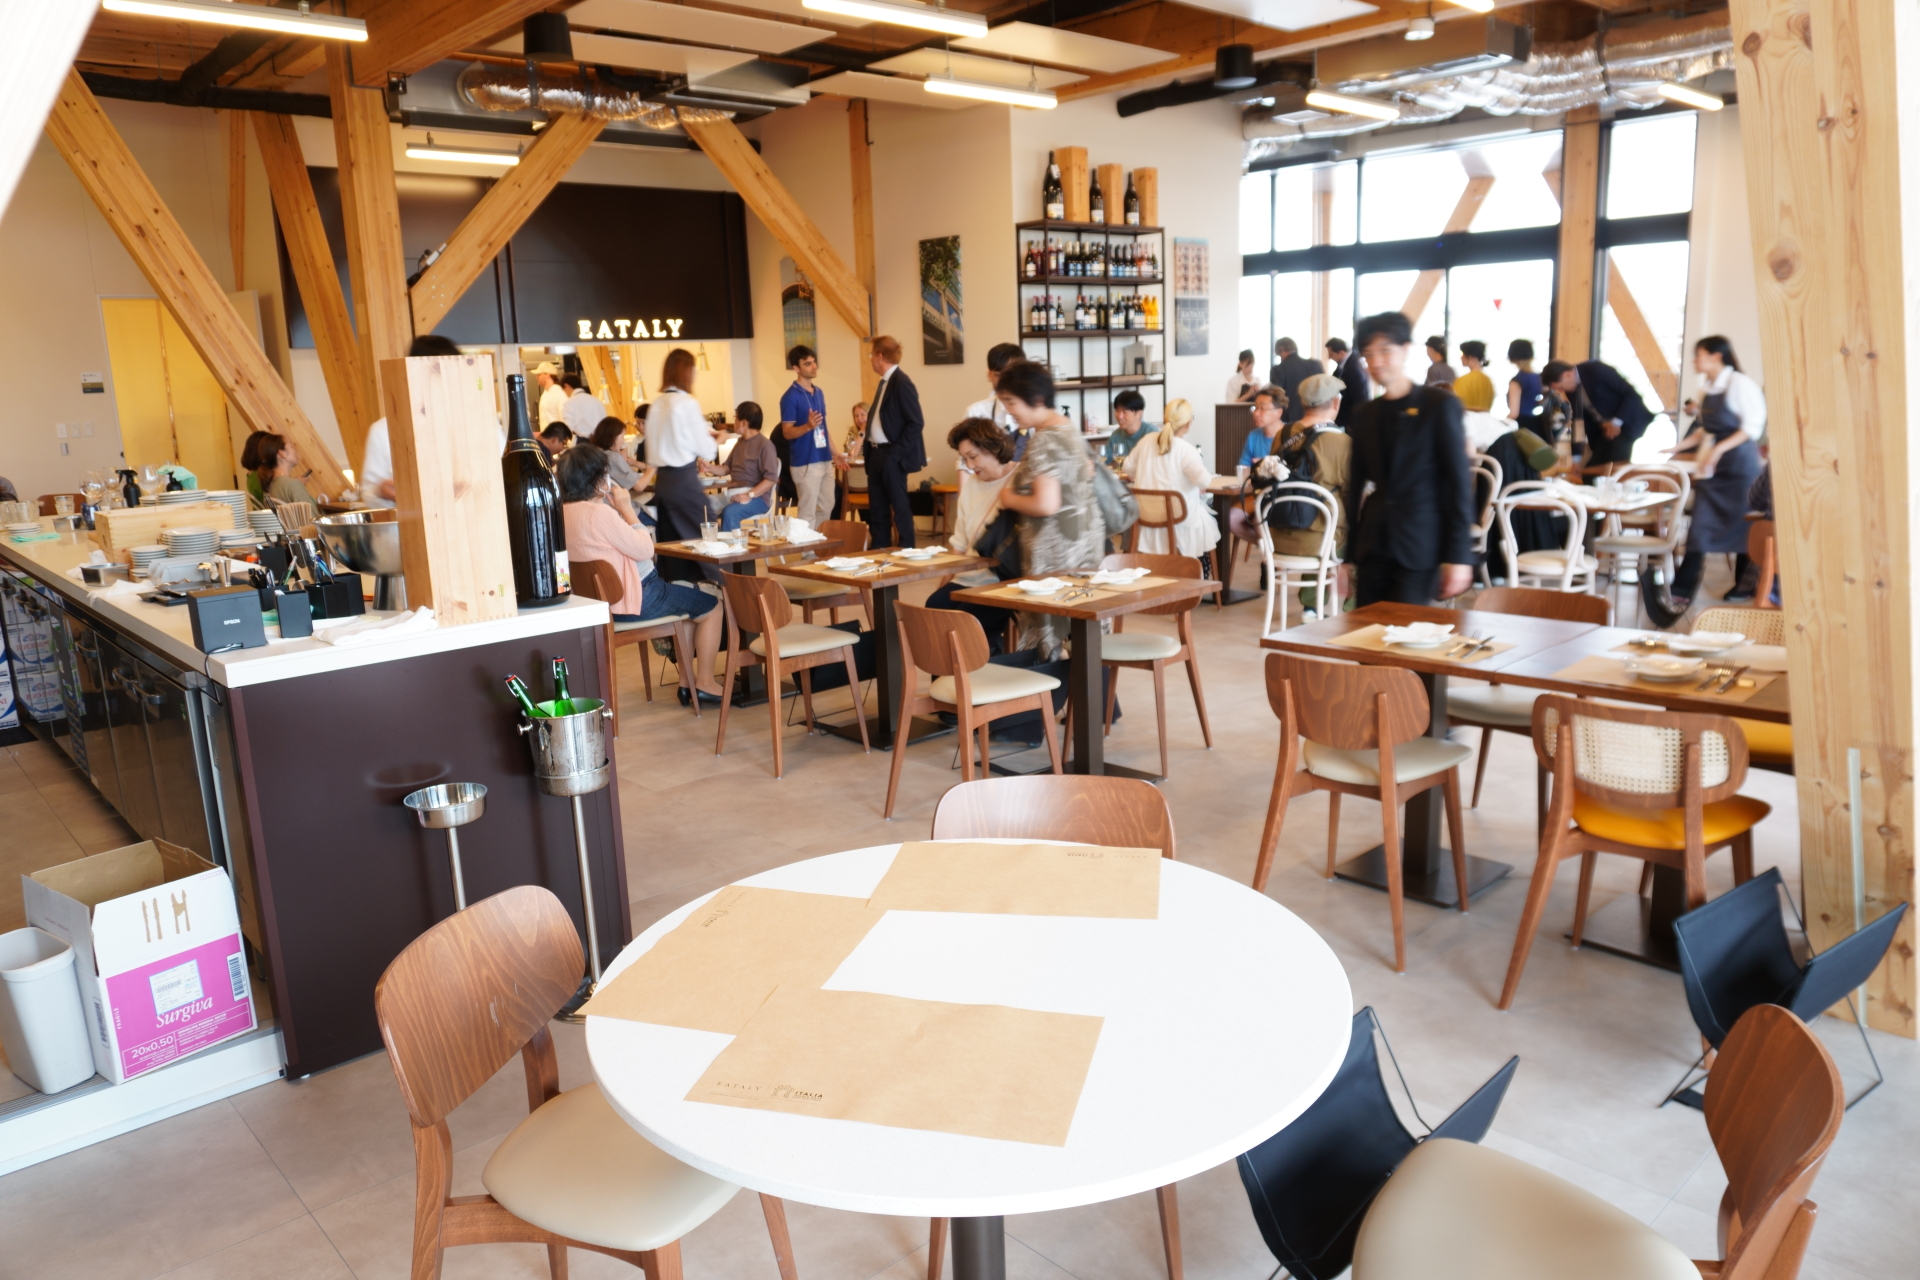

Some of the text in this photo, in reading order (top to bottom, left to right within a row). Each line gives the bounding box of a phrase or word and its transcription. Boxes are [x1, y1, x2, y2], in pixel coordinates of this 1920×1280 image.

[577, 318, 684, 339] EATALY
[223, 618, 241, 626] EPSON
[156, 996, 214, 1029] Surgiva
[131, 1035, 174, 1059] 20x0,50
[716, 1081, 763, 1091] EATALY
[795, 1090, 823, 1098] ITALIA
